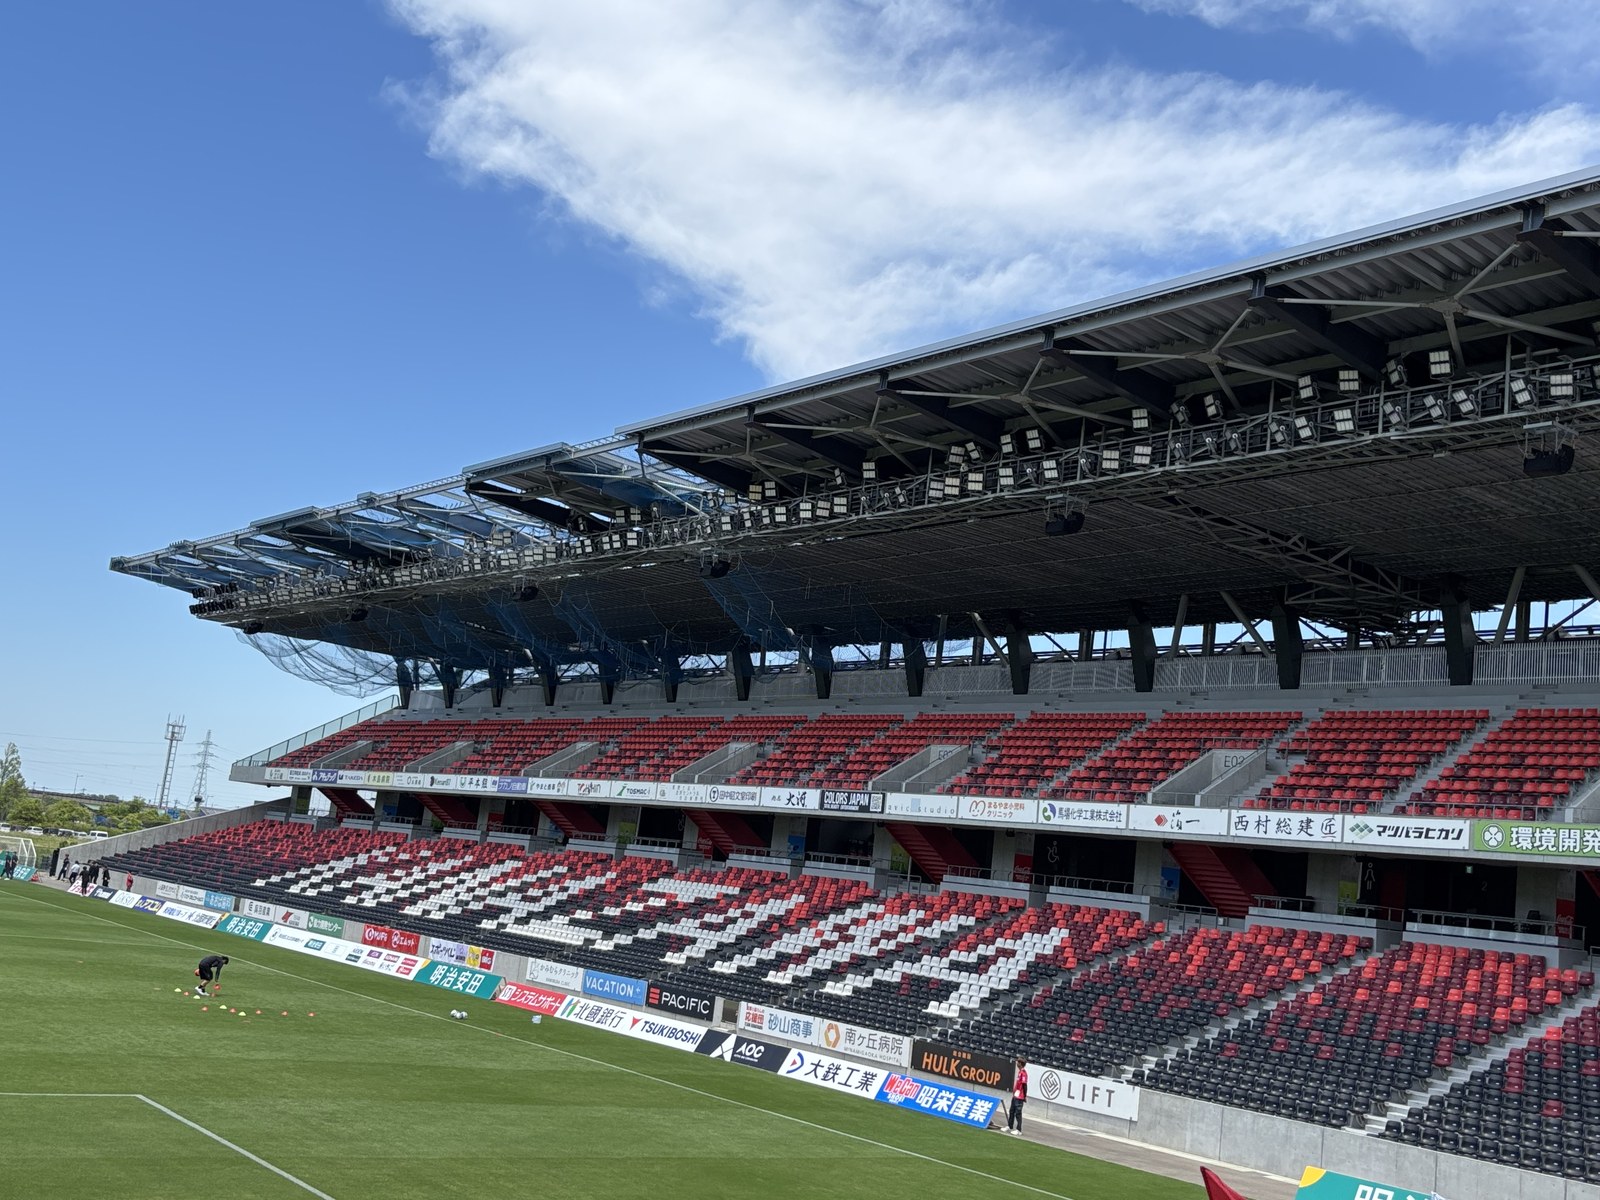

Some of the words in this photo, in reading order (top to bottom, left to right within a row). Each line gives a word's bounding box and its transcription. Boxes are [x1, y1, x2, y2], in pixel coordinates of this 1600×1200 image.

[823, 791, 848, 804] COLORS
[849, 793, 869, 806] JAPAN
[918, 805, 955, 815] studio
[987, 801, 1025, 811] まるやま小児科
[987, 811, 1014, 819] クリニック
[1058, 807, 1123, 823] 馬場化学工業株式会社
[1234, 814, 1338, 838] 西村総建匠
[1375, 824, 1464, 841] マツバラヒカリ
[1510, 826, 1600, 853] 環境開発
[226, 916, 264, 938] 明治安田
[430, 964, 486, 994] 明治安田
[539, 963, 579, 979] かみむらクリニック
[586, 975, 634, 997] VACATION
[511, 988, 562, 1012] システムサポート
[661, 991, 711, 1014] PACIFIC
[573, 1002, 627, 1029] 北國銀行
[768, 1012, 813, 1039] 砂山商事
[640, 1020, 702, 1045] TSUKIBOSHI
[735, 1041, 765, 1058] AOC
[804, 1059, 878, 1093] 大鉄工業
[922, 1051, 961, 1077] HULK
[960, 1065, 1001, 1085] GROUP
[883, 1073, 921, 1098] WeCan
[1067, 1080, 1115, 1108] LIFT
[915, 1085, 994, 1124] 昭栄産業
